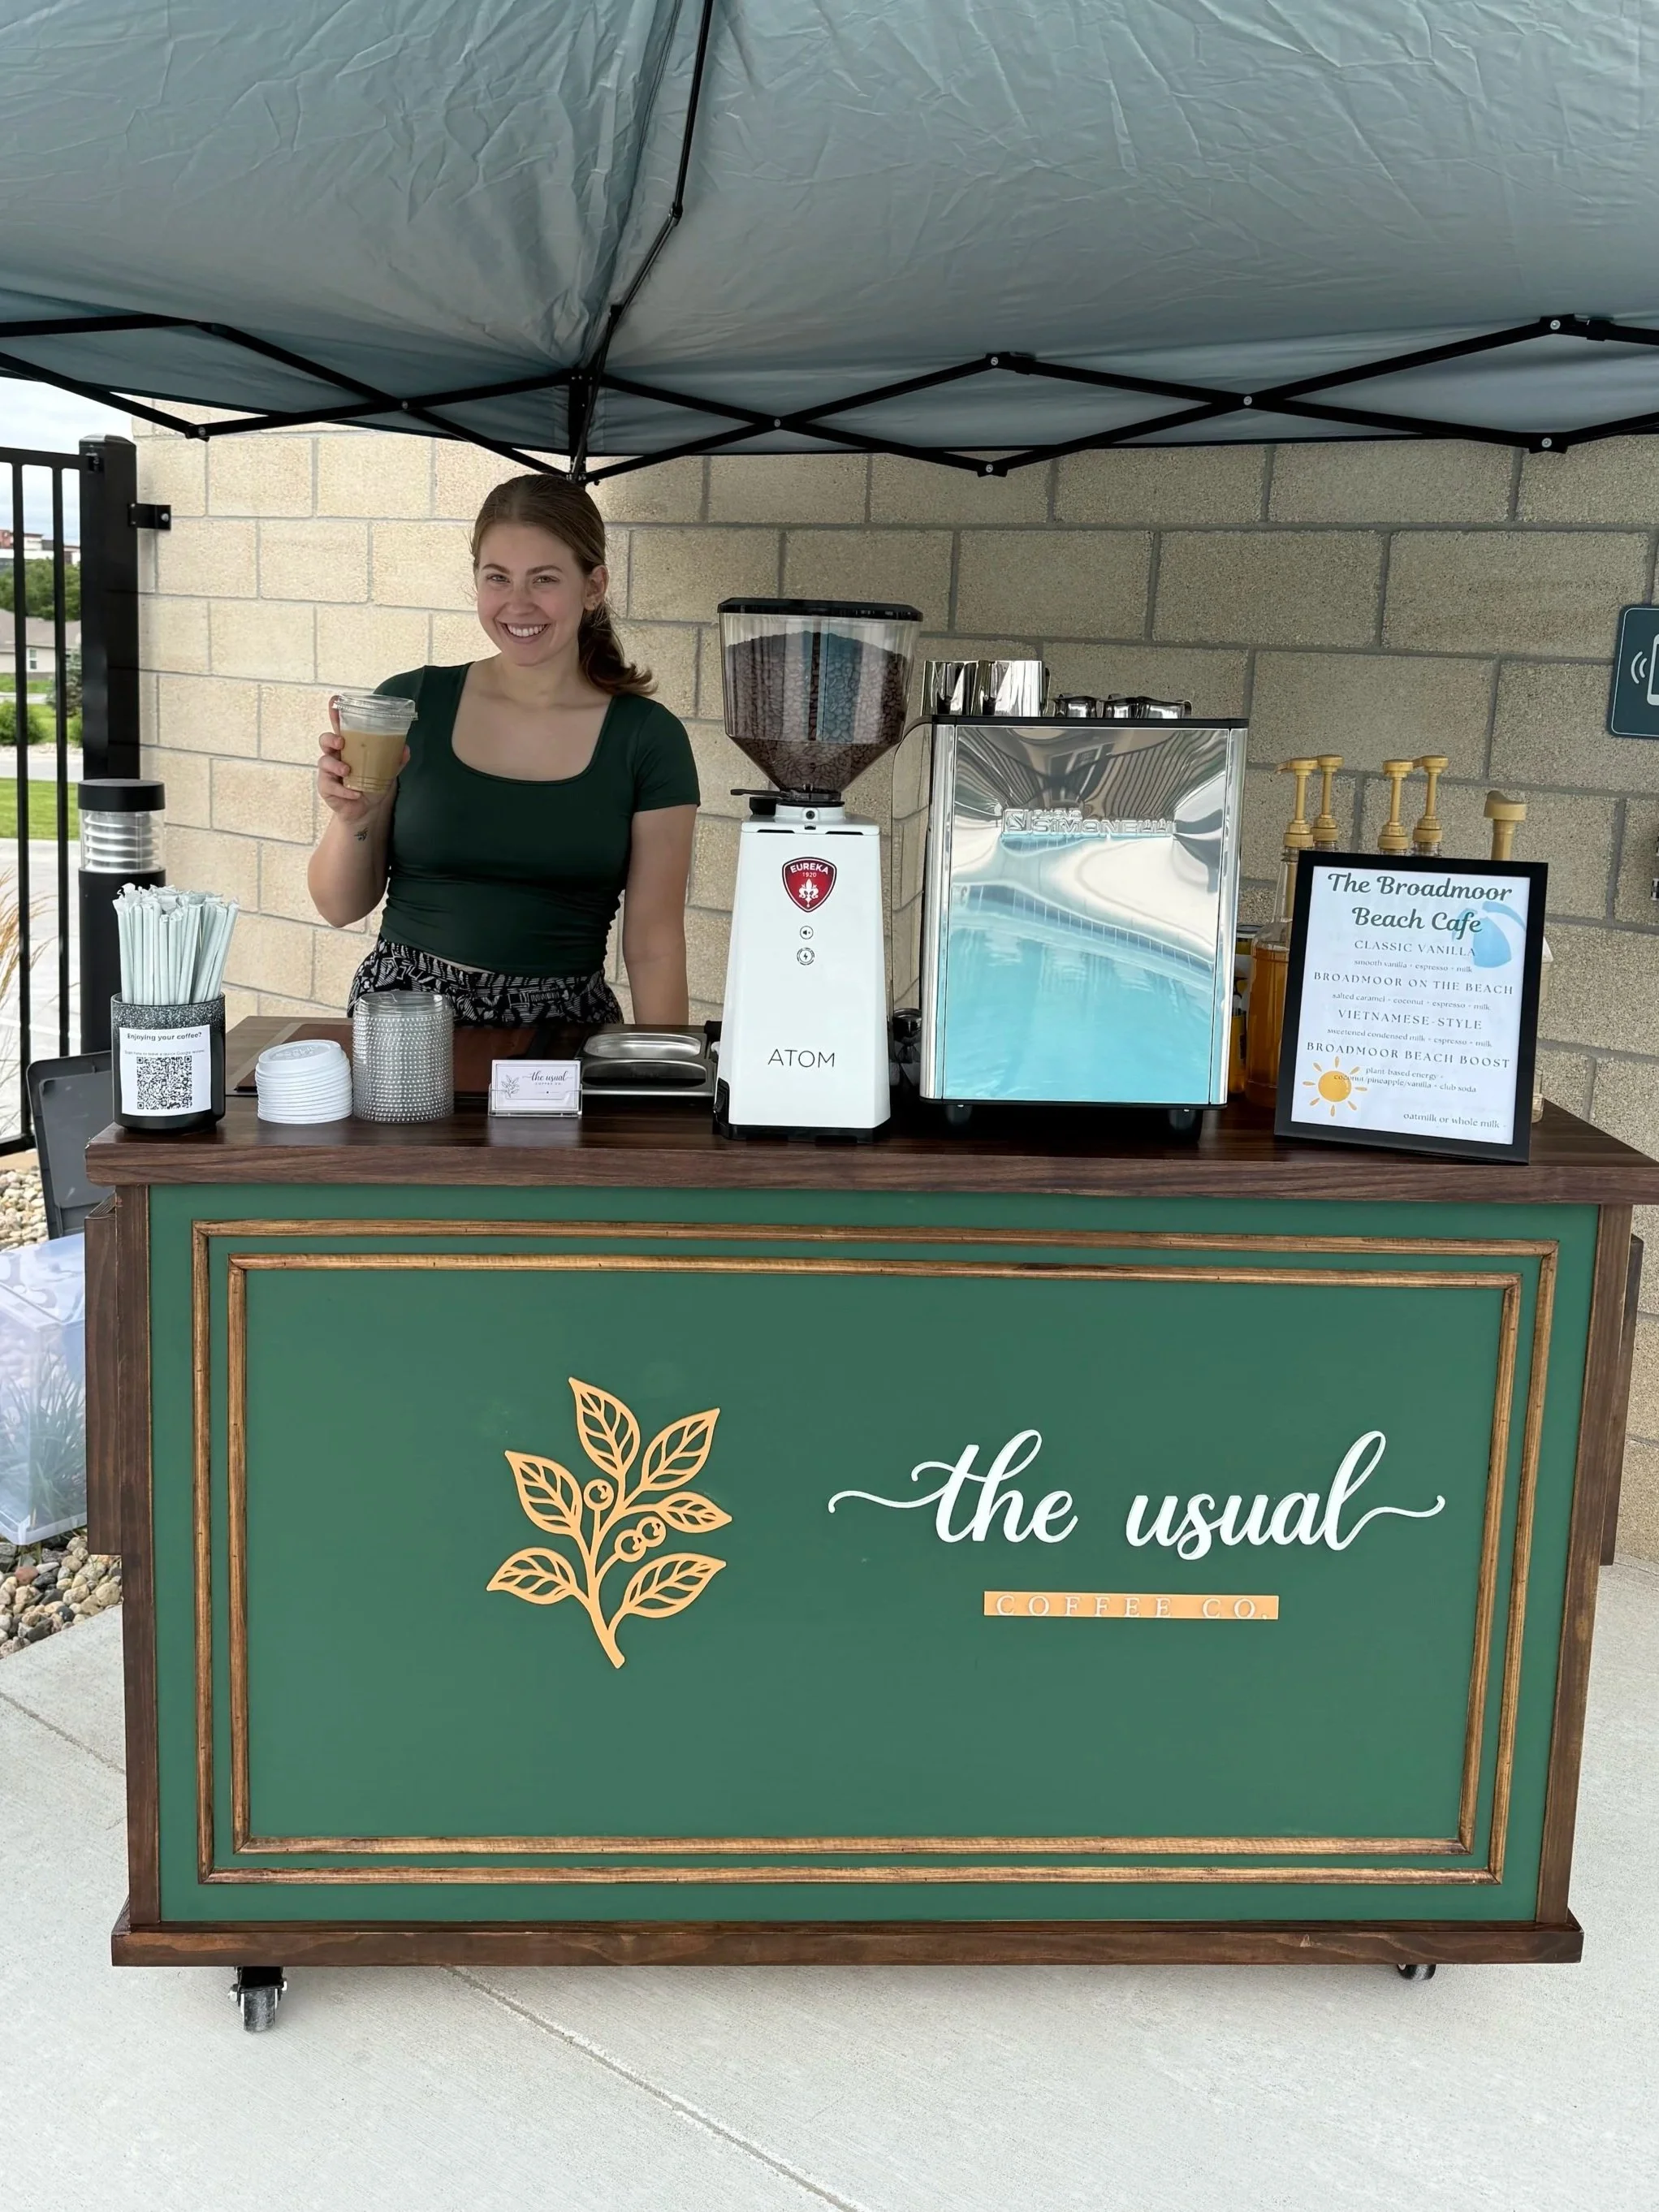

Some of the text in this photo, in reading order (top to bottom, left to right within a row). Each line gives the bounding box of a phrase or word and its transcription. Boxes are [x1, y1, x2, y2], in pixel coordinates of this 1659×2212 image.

[790, 862, 828, 875] EUREKA
[1328, 872, 1512, 901] The Broadmoor
[1351, 907, 1483, 940] Beach Cafe
[1354, 940, 1476, 957] CLASSIC VANILLA
[1314, 971, 1513, 995] BROADMOOR ON THE BEACH
[1332, 992, 1354, 1000] salted
[1355, 994, 1385, 1003] caramel
[1432, 1000, 1466, 1009] espresso
[1473, 1003, 1490, 1011] milk
[1338, 1009, 1482, 1030] VIETNAMESE-STYLE
[127, 1033, 156, 1042] Enjoying
[176, 1031, 202, 1039] coffee?
[1327, 1028, 1366, 1037] sweetened
[1367, 1031, 1408, 1040] condensed
[1409, 1034, 1426, 1042] milk
[767, 1048, 835, 1068] ATOM
[1307, 1042, 1510, 1068] BROADMOOR BEACH BOOST
[522, 1070, 573, 1082] the usual
[1366, 1067, 1437, 1081] plant based energy
[1439, 1082, 1457, 1091] club
[1458, 1085, 1477, 1093] soda
[1403, 1113, 1437, 1122] oatmilk
[1451, 1117, 1479, 1126] whole
[1480, 1120, 1500, 1128] milk
[827, 1429, 1446, 1561] the usual
[995, 1594, 1173, 1618] COFFEE
